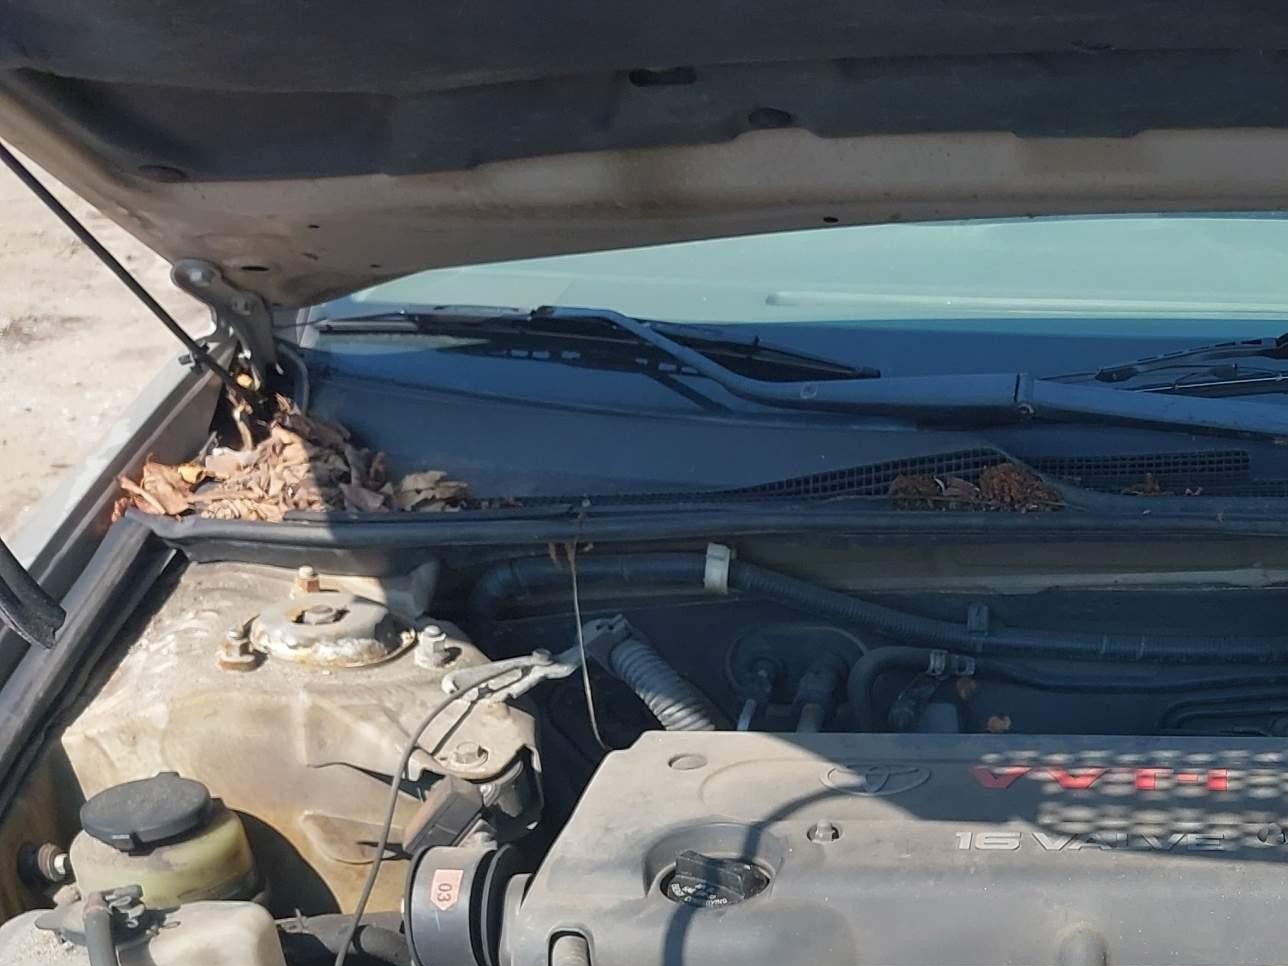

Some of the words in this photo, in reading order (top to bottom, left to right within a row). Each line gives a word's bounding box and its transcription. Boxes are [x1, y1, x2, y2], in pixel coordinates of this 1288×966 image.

[955, 831, 1022, 850] 16
[1031, 832, 1225, 851] VALVE
[436, 882, 453, 903] 03
